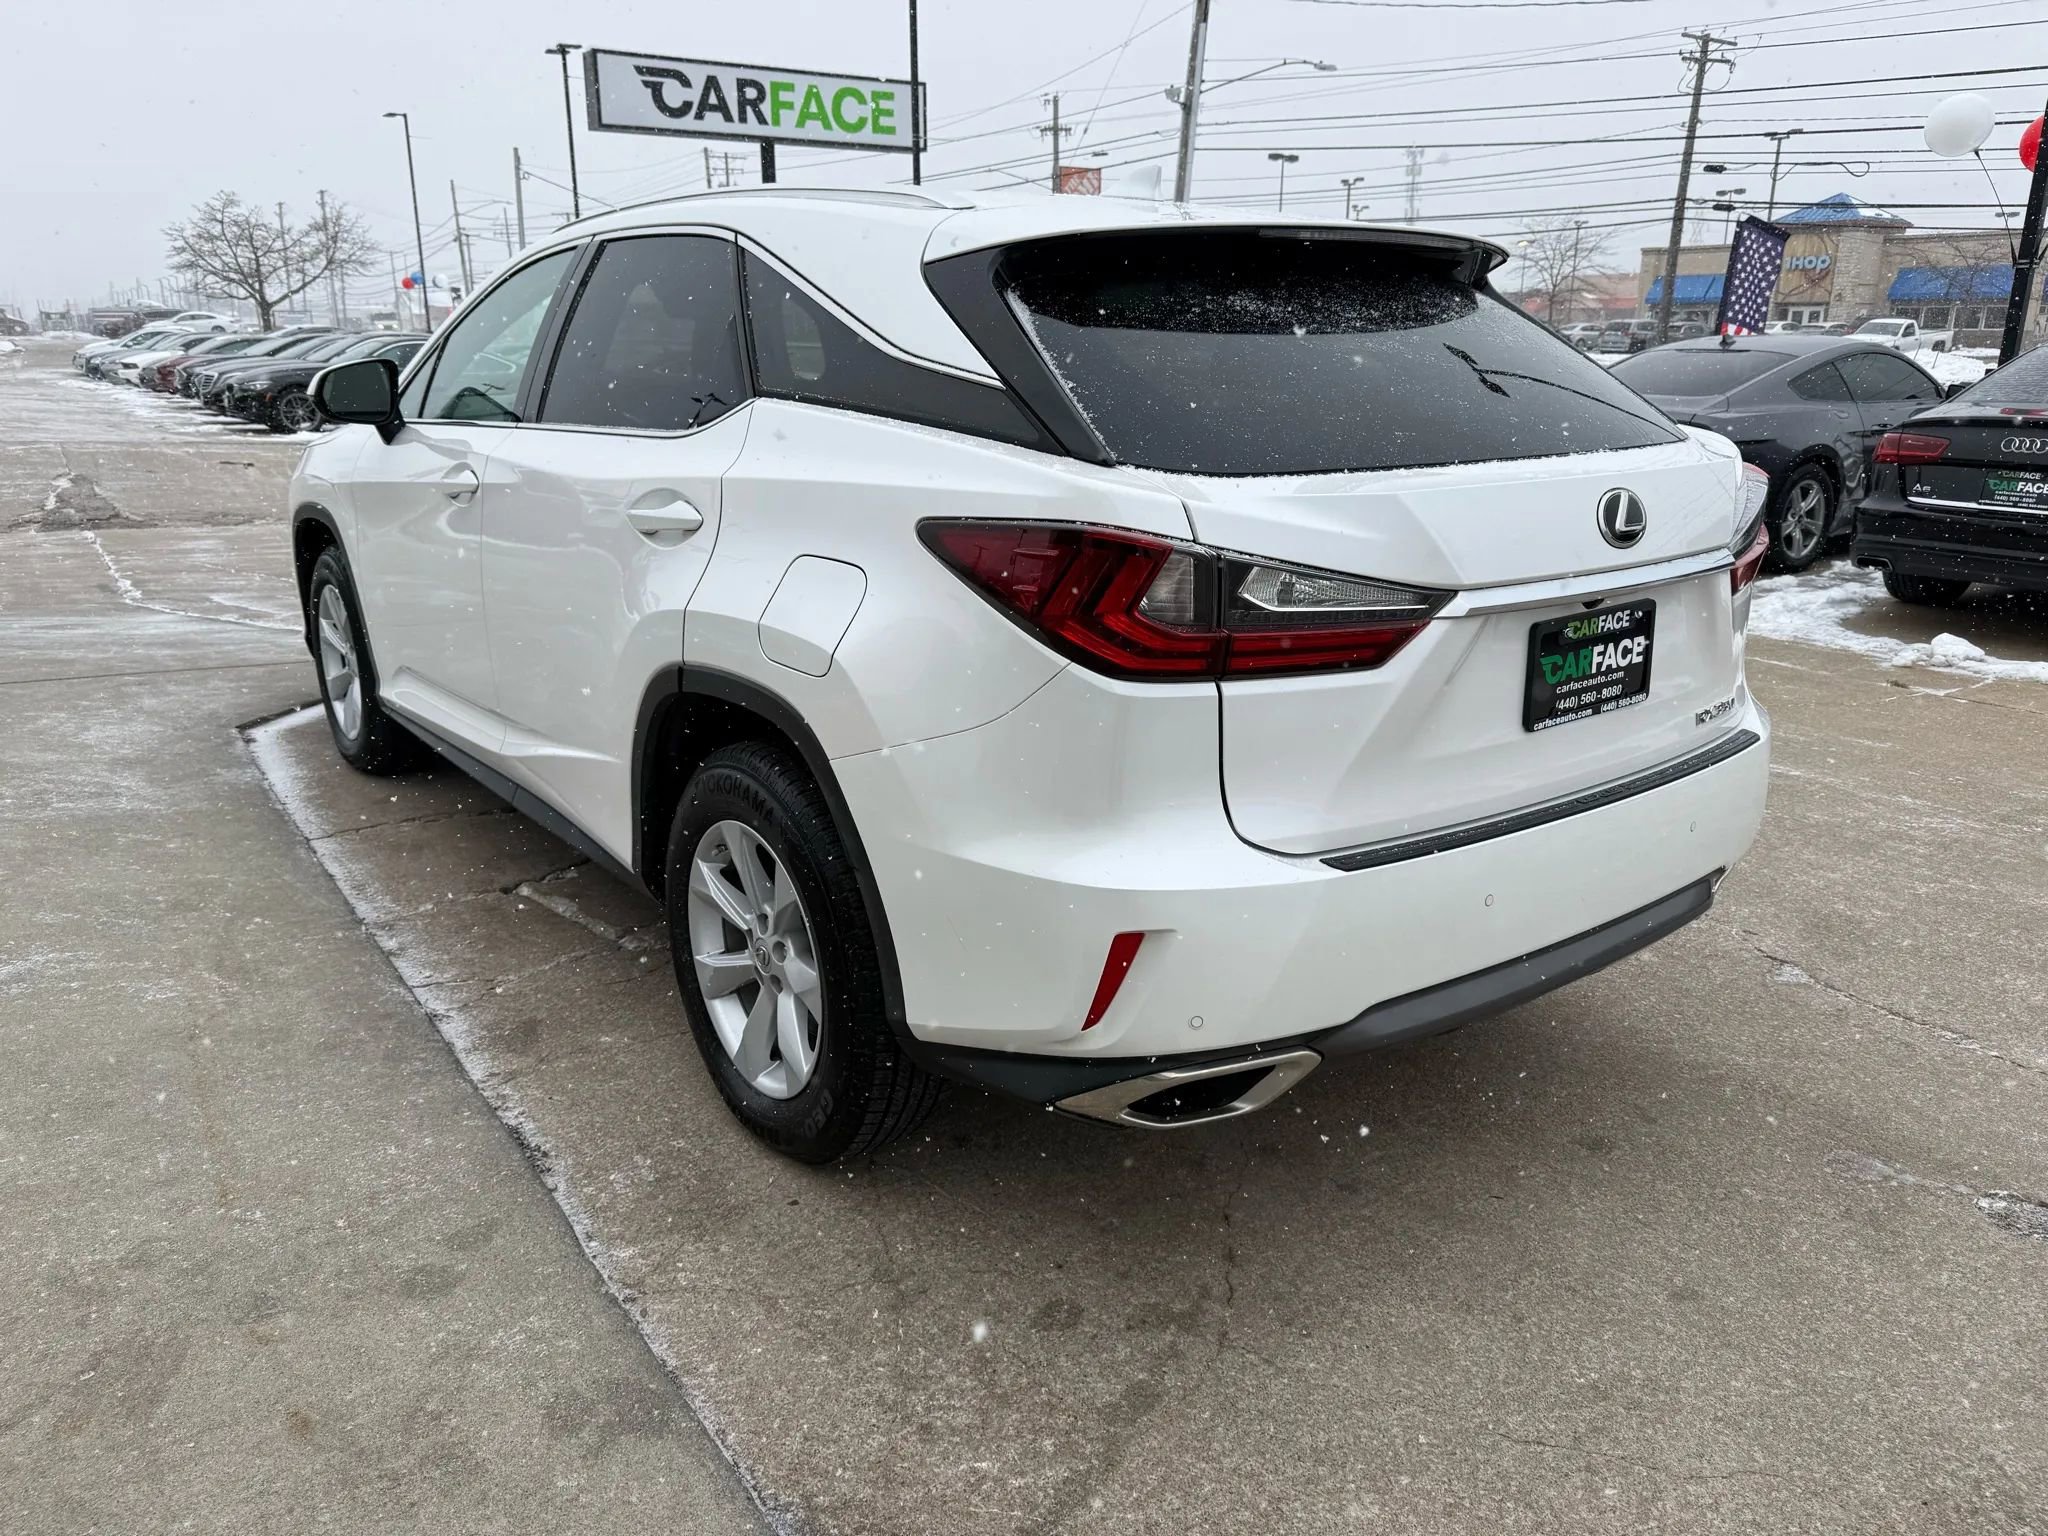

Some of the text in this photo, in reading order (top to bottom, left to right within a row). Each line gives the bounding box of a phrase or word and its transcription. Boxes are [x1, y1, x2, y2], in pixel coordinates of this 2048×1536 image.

[632, 65, 897, 136] CARFACE
[1783, 255, 1831, 274] IHOP
[1567, 610, 1631, 640] CARFACE
[1540, 635, 1646, 685] CARFACE
[1556, 671, 1625, 694] carfaceauto.com
[1533, 708, 1593, 731] carfaceauto.com
[1600, 701, 1617, 713] (440)
[1556, 696, 1578, 711] (440)
